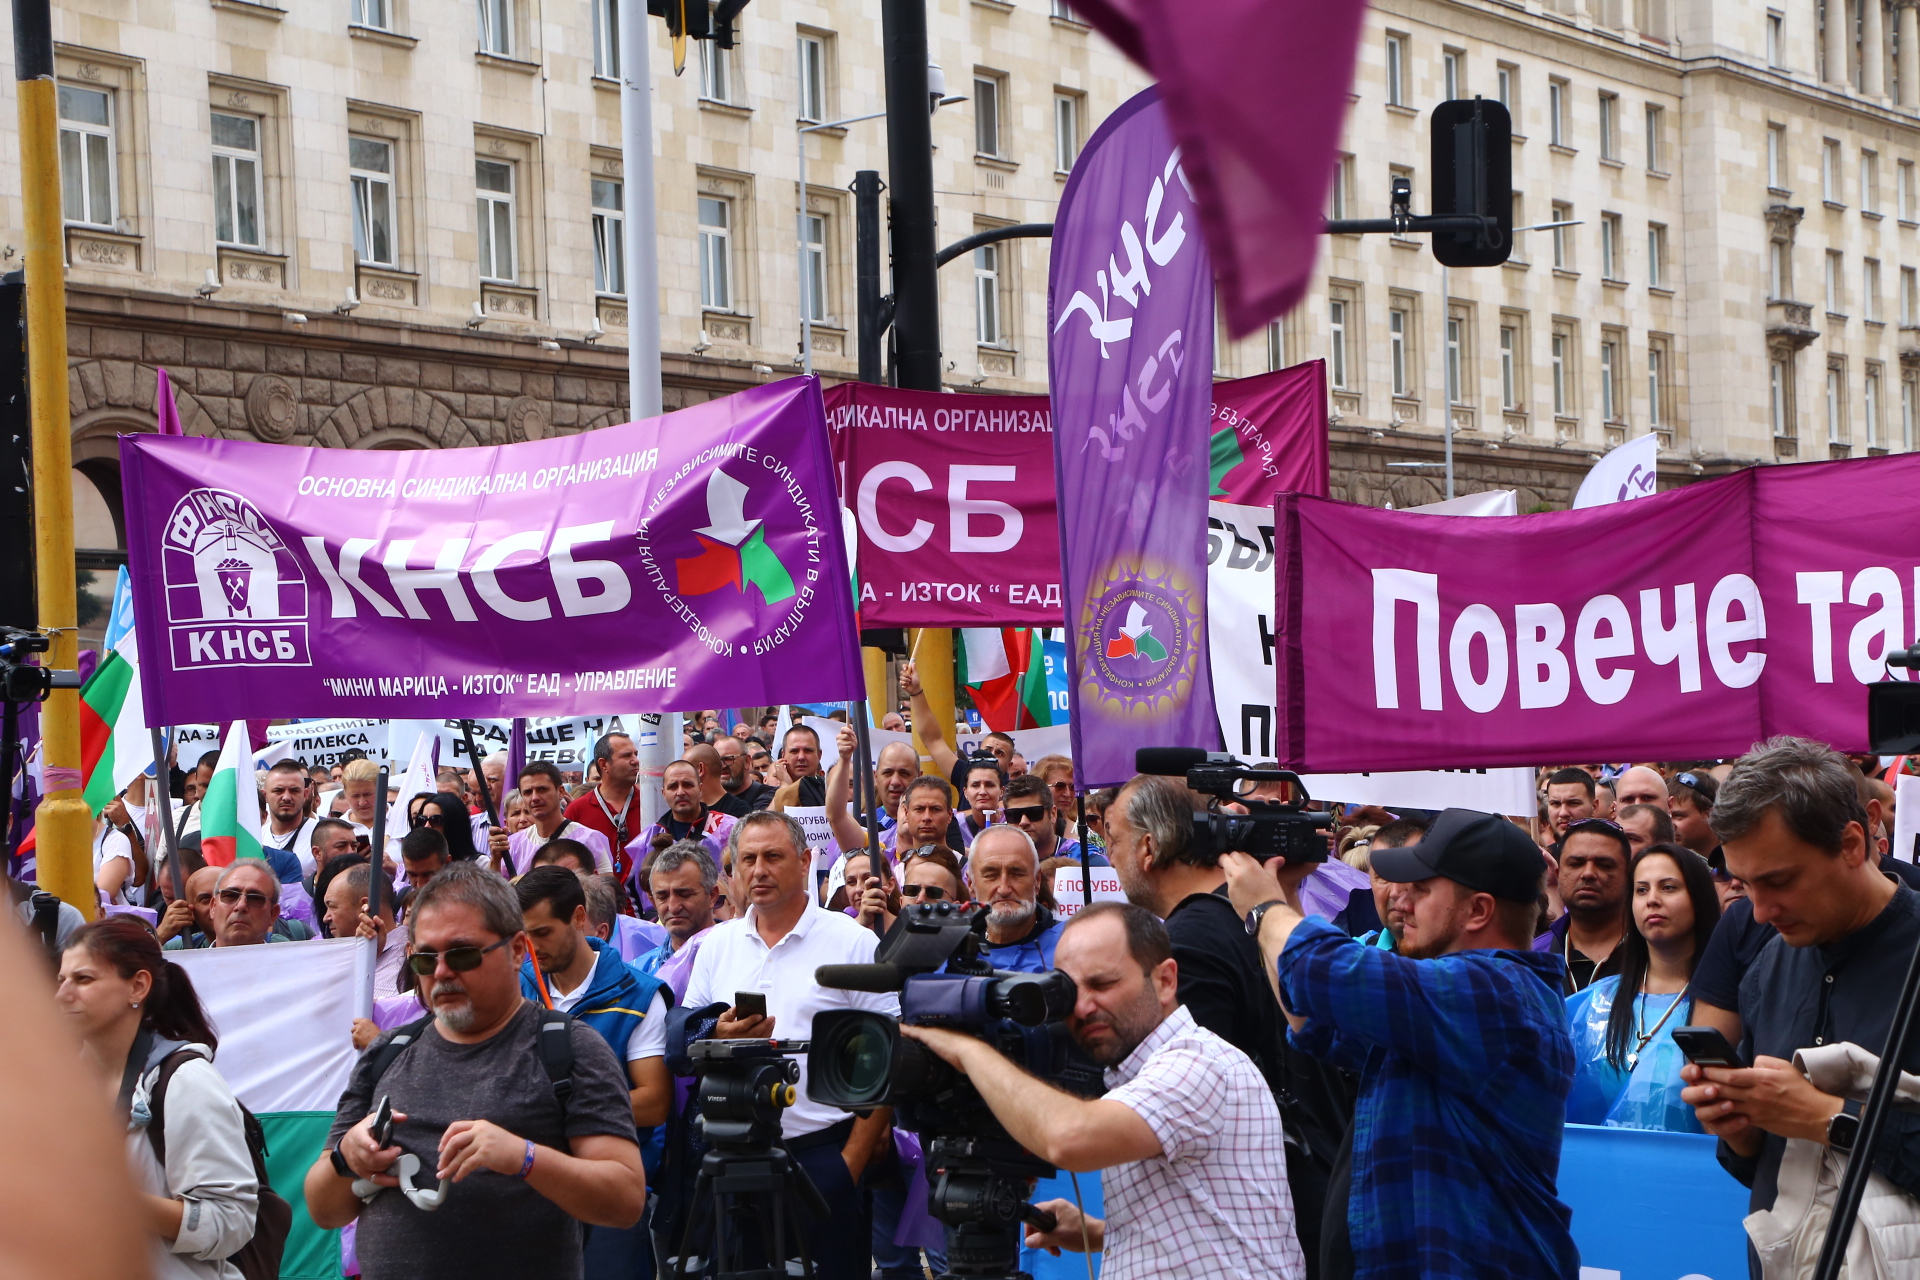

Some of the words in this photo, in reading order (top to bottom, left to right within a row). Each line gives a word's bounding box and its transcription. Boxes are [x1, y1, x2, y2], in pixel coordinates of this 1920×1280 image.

[826, 404, 928, 434] НДИКАЛНА
[1219, 407, 1278, 478] БЪЛГАРИЯ
[298, 475, 396, 499] ОСНОВНА
[401, 471, 527, 501] СИНДИКАЛНА
[532, 447, 659, 490] ОРГАНИЗАЦИЯ
[648, 442, 758, 512] НЕЗАВИСИМИТЕ
[762, 455, 820, 563] СИНДИКАТИ
[838, 460, 1024, 553] СБ
[636, 517, 651, 540] НА
[301, 520, 632, 622] КНСБ
[806, 568, 819, 582] В
[638, 546, 733, 657] КОНФЕДЕРАЦИЯ
[900, 581, 982, 603] ИЗТОК
[1008, 583, 1062, 607] ЕАД
[753, 585, 815, 656] БЪЛГАРИЯ
[1096, 617, 1104, 632] НА
[1155, 597, 1182, 646] СИНДИКАТИ
[188, 629, 296, 662] КНСБ
[1371, 568, 1767, 714] Повече
[1796, 566, 1920, 686] та
[1093, 632, 1134, 688] КОНФЕДЕРАЦИЯ
[1146, 656, 1178, 687] БЪЛГАРИЯ
[379, 675, 449, 699] МАРИЦА
[527, 672, 561, 697] ЕАД
[574, 667, 677, 692] УПРАВЛЕНИЕ
[178, 729, 202, 744] ДА
[284, 718, 375, 737] РАБОТНИТЕ
[292, 733, 369, 752] ПЛЕКСА
[444, 719, 575, 745] БЪДЩЕ
[583, 715, 626, 738] НА
[1066, 880, 1122, 892] ПОУБВ
[1058, 904, 1085, 916] РЕГ
